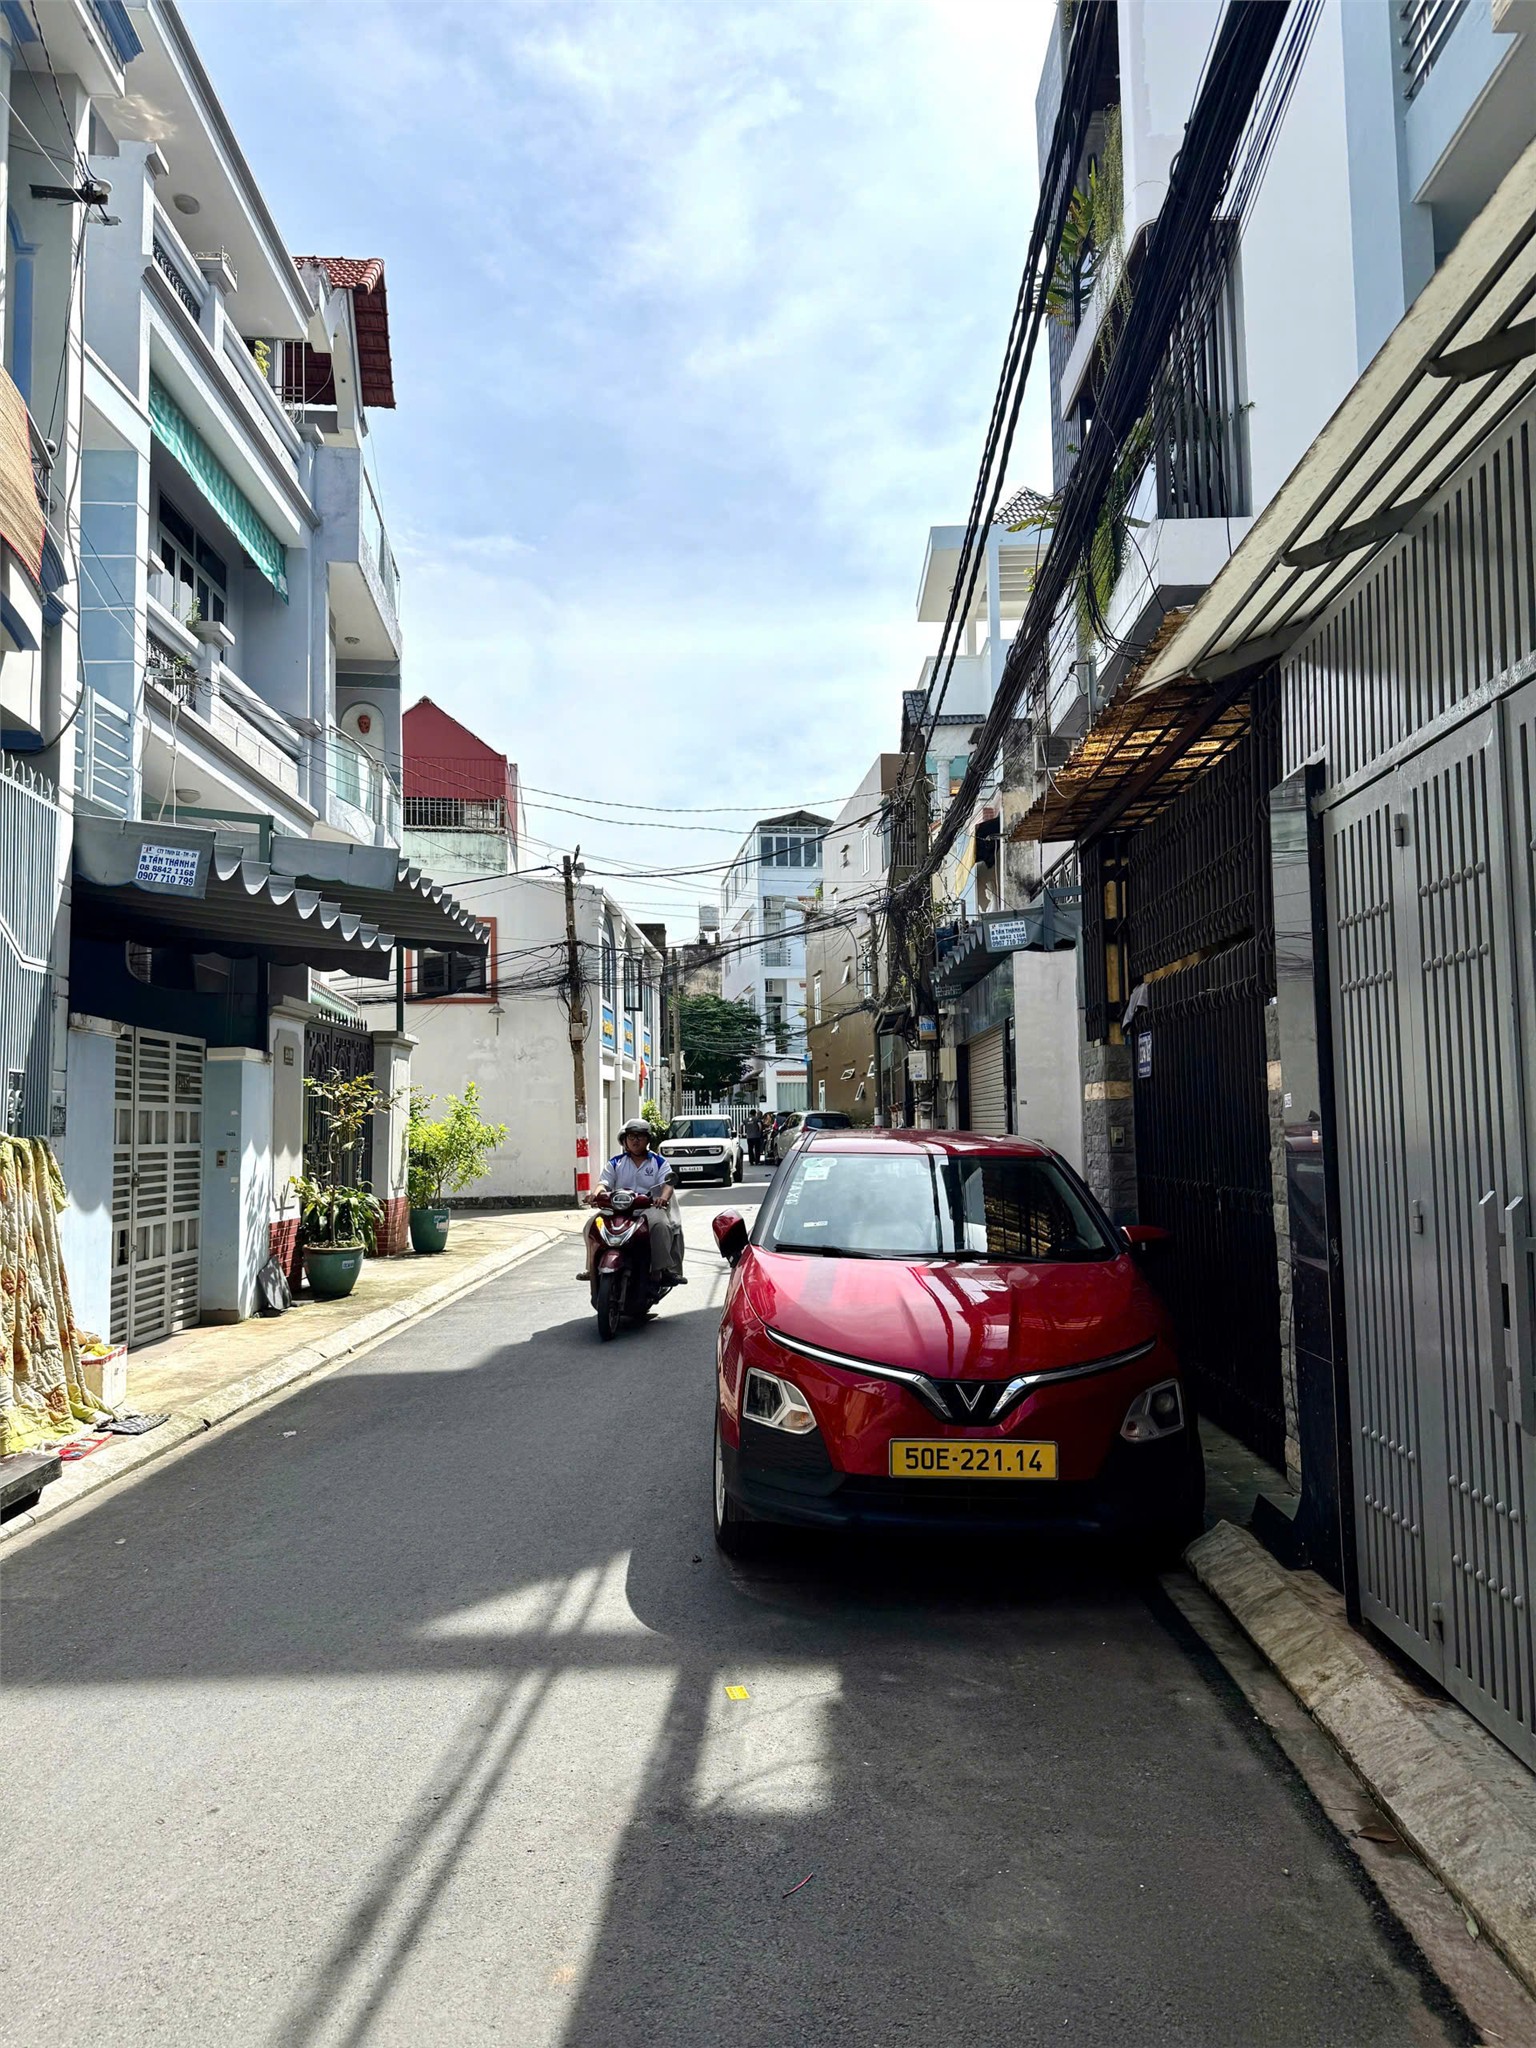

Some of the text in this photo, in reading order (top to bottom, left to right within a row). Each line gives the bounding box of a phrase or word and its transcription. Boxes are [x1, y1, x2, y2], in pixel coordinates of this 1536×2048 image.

[152, 865, 172, 873] 8842
[174, 868, 194, 876] 1168
[137, 871, 194, 886] 0907 710 799
[905, 1447, 1042, 1471] 50E-221.14
